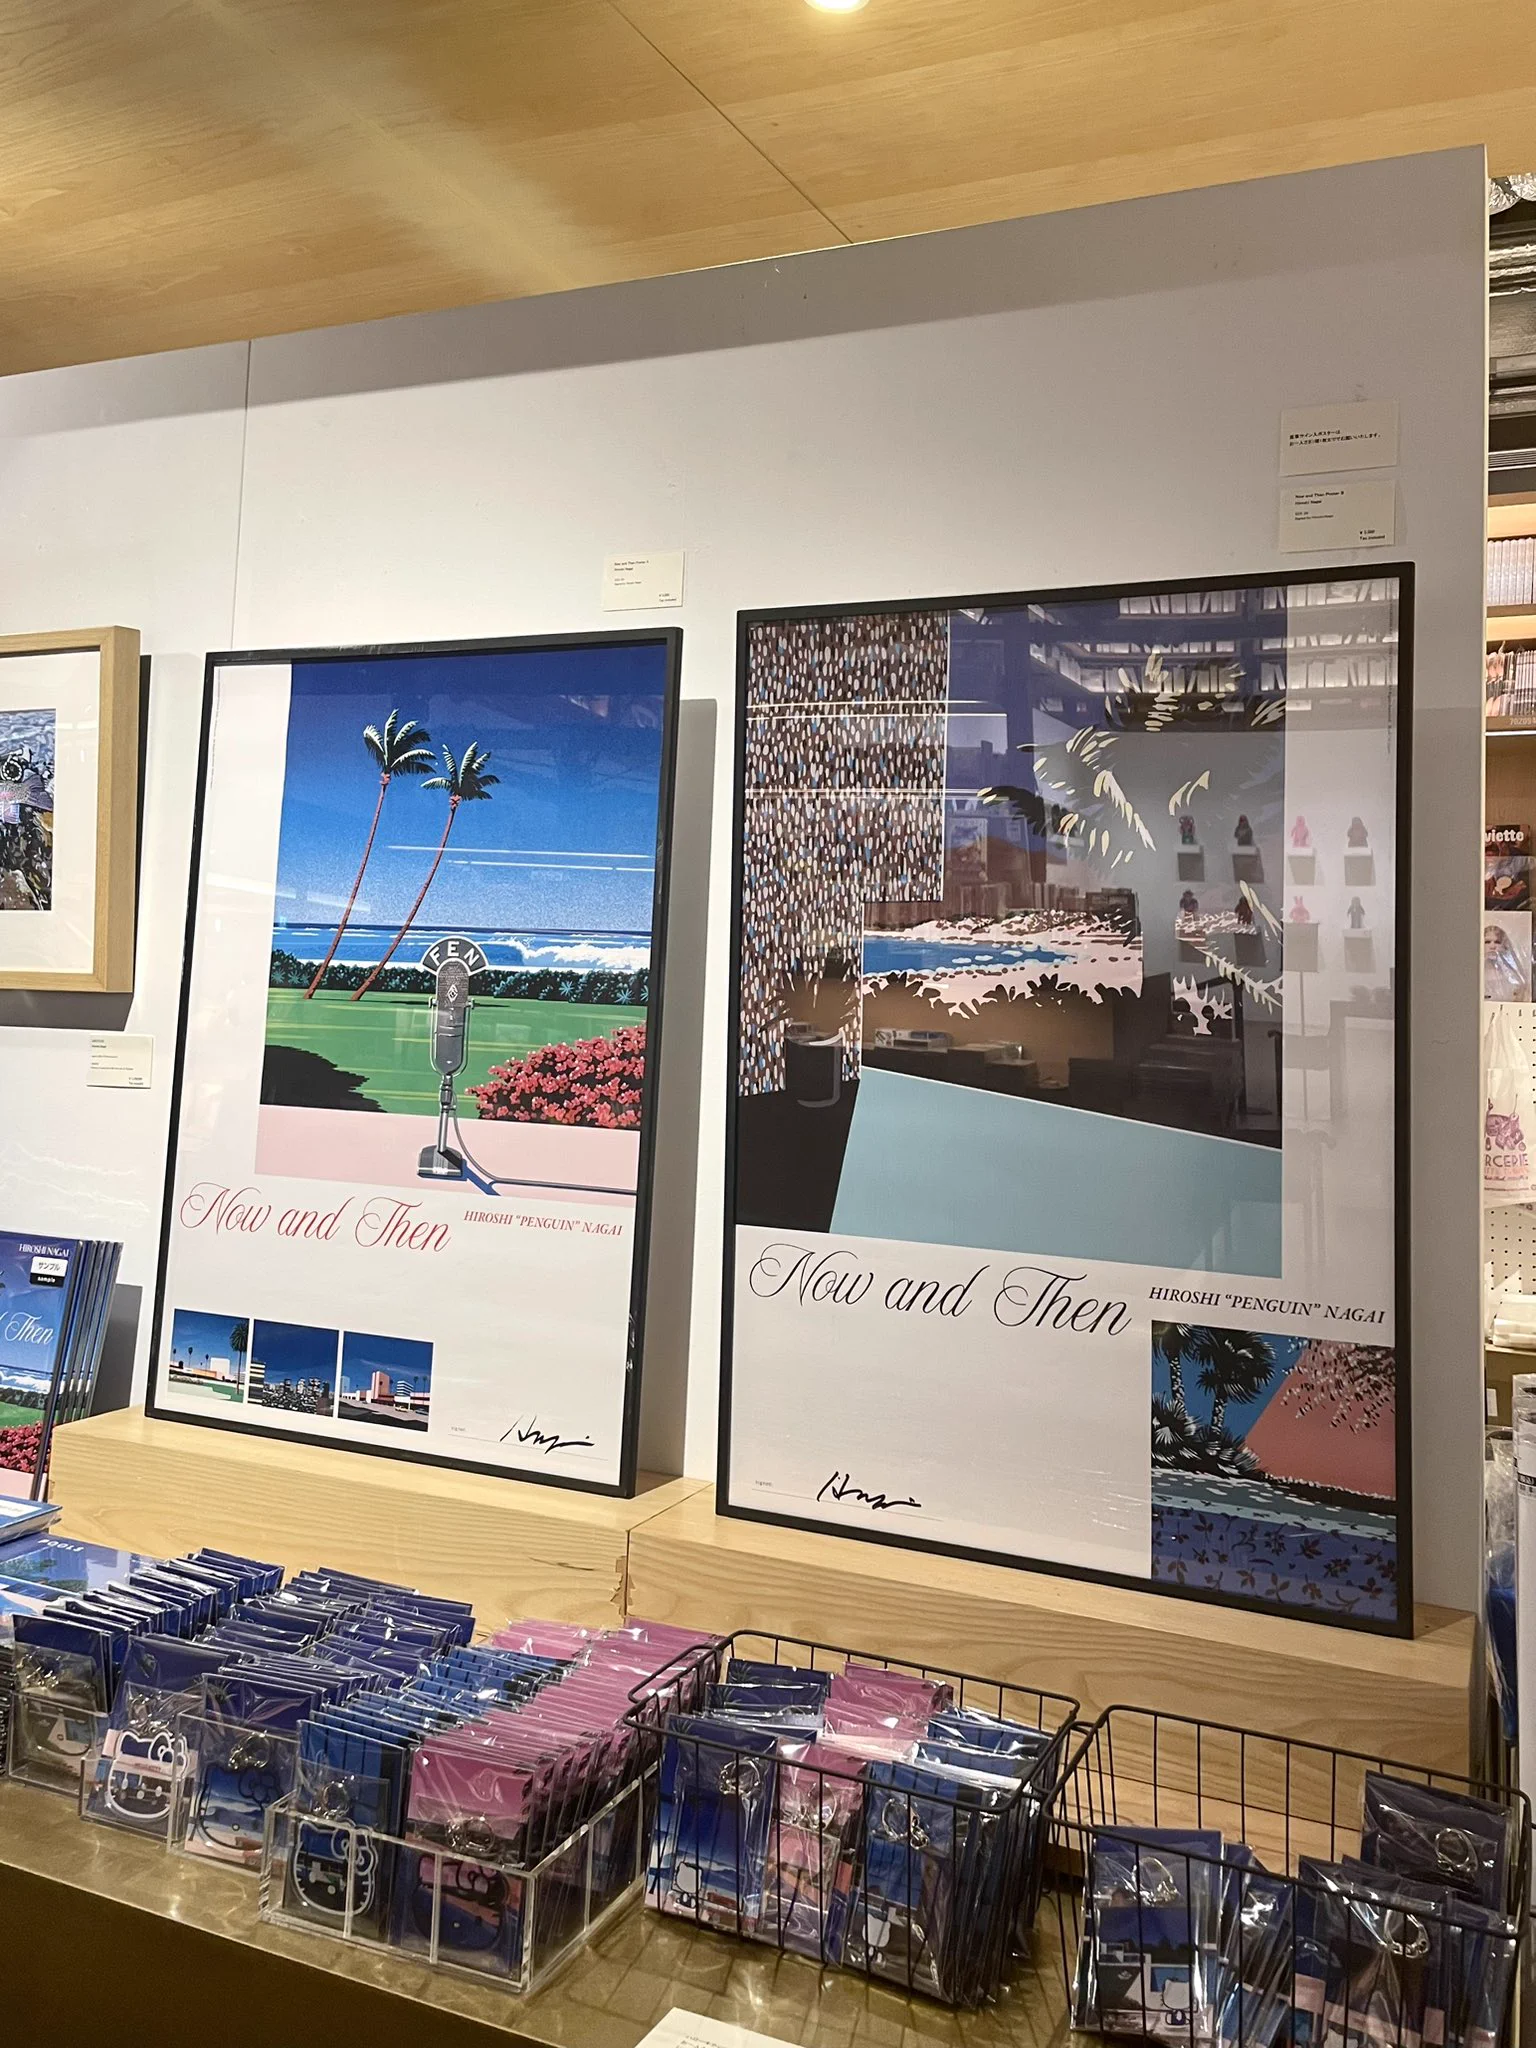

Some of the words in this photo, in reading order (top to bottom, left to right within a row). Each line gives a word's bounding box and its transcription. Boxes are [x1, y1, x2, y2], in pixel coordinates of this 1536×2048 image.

[429, 940, 480, 967] FEN
[180, 1182, 272, 1235] Now
[277, 1196, 356, 1241] and
[355, 1196, 452, 1253] Then
[463, 1210, 513, 1225] HIROSHI
[581, 1221, 623, 1236] NAGAI
[19, 1243, 47, 1255] HIROSHI
[38, 1262, 61, 1271] サンプル
[750, 1243, 875, 1307] Now
[883, 1265, 991, 1318] and
[993, 1266, 1133, 1337] Then
[1149, 1286, 1222, 1307] HIROSHI
[1324, 1304, 1387, 1325] NAGAI
[4, 1311, 55, 1345] Then
